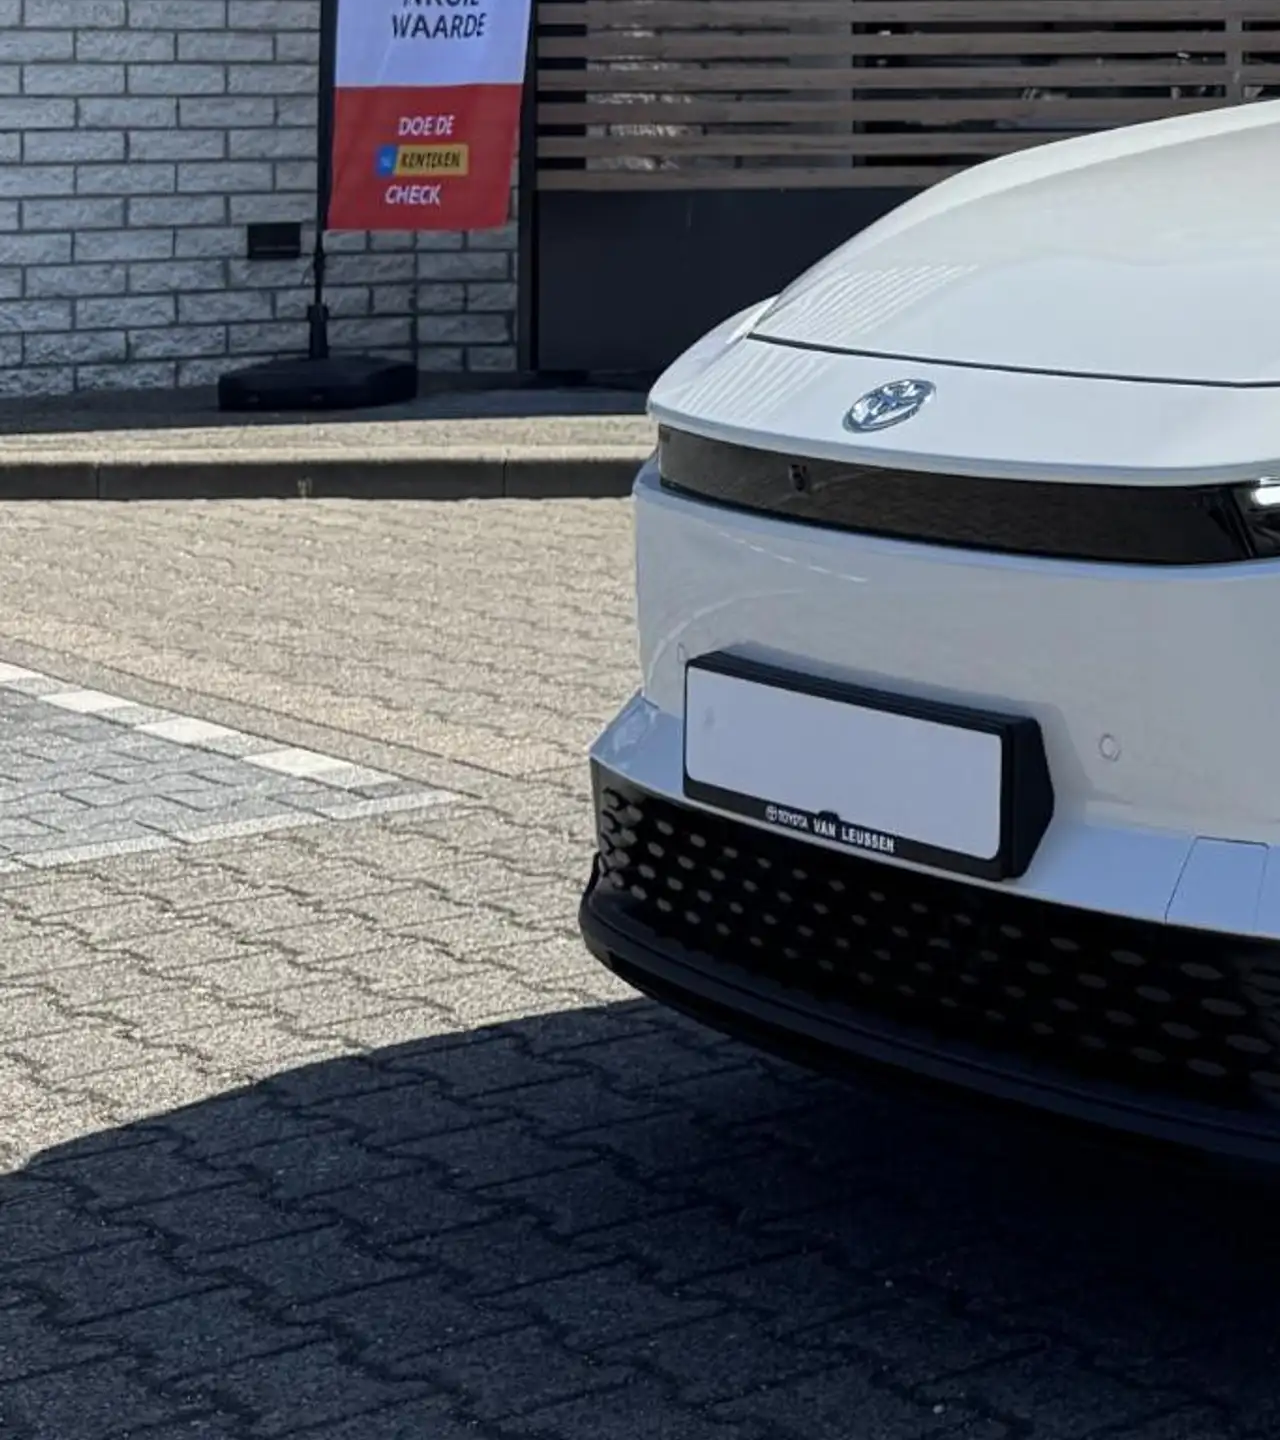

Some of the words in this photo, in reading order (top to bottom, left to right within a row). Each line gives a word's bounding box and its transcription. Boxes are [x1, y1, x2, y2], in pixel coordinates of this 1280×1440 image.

[392, 12, 488, 40] WAARDE
[398, 115, 433, 137] DOE
[434, 114, 456, 136] DE
[385, 183, 442, 207] CHECK
[778, 810, 809, 829] TOYOTA
[813, 817, 837, 839] VAN
[842, 825, 895, 854] LEUSSEN
